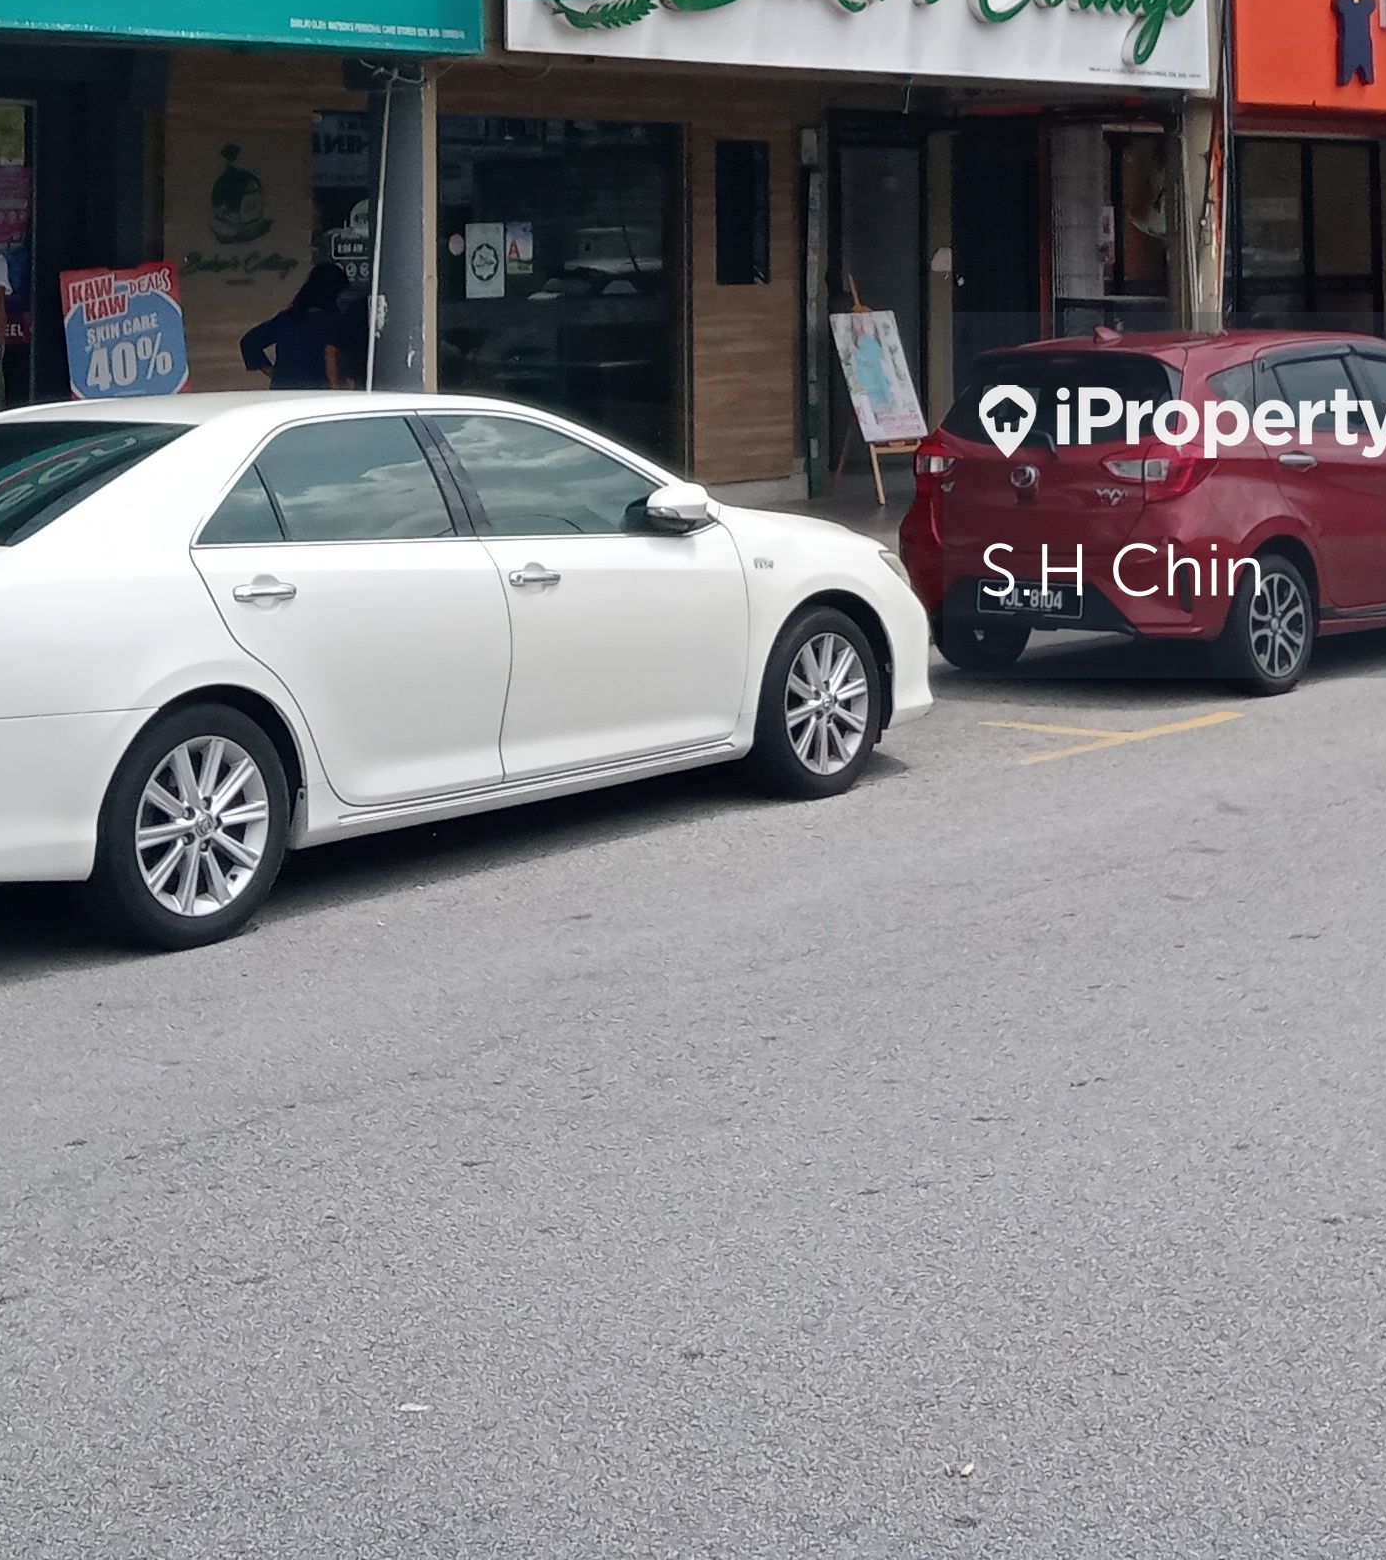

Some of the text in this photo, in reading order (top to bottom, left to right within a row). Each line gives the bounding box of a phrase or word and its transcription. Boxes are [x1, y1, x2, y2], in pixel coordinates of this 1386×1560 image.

[70, 268, 172, 305] KAW DEALS
[84, 294, 128, 324] KAW
[86, 312, 160, 345] SKIN CARE
[86, 331, 173, 392] 40%
